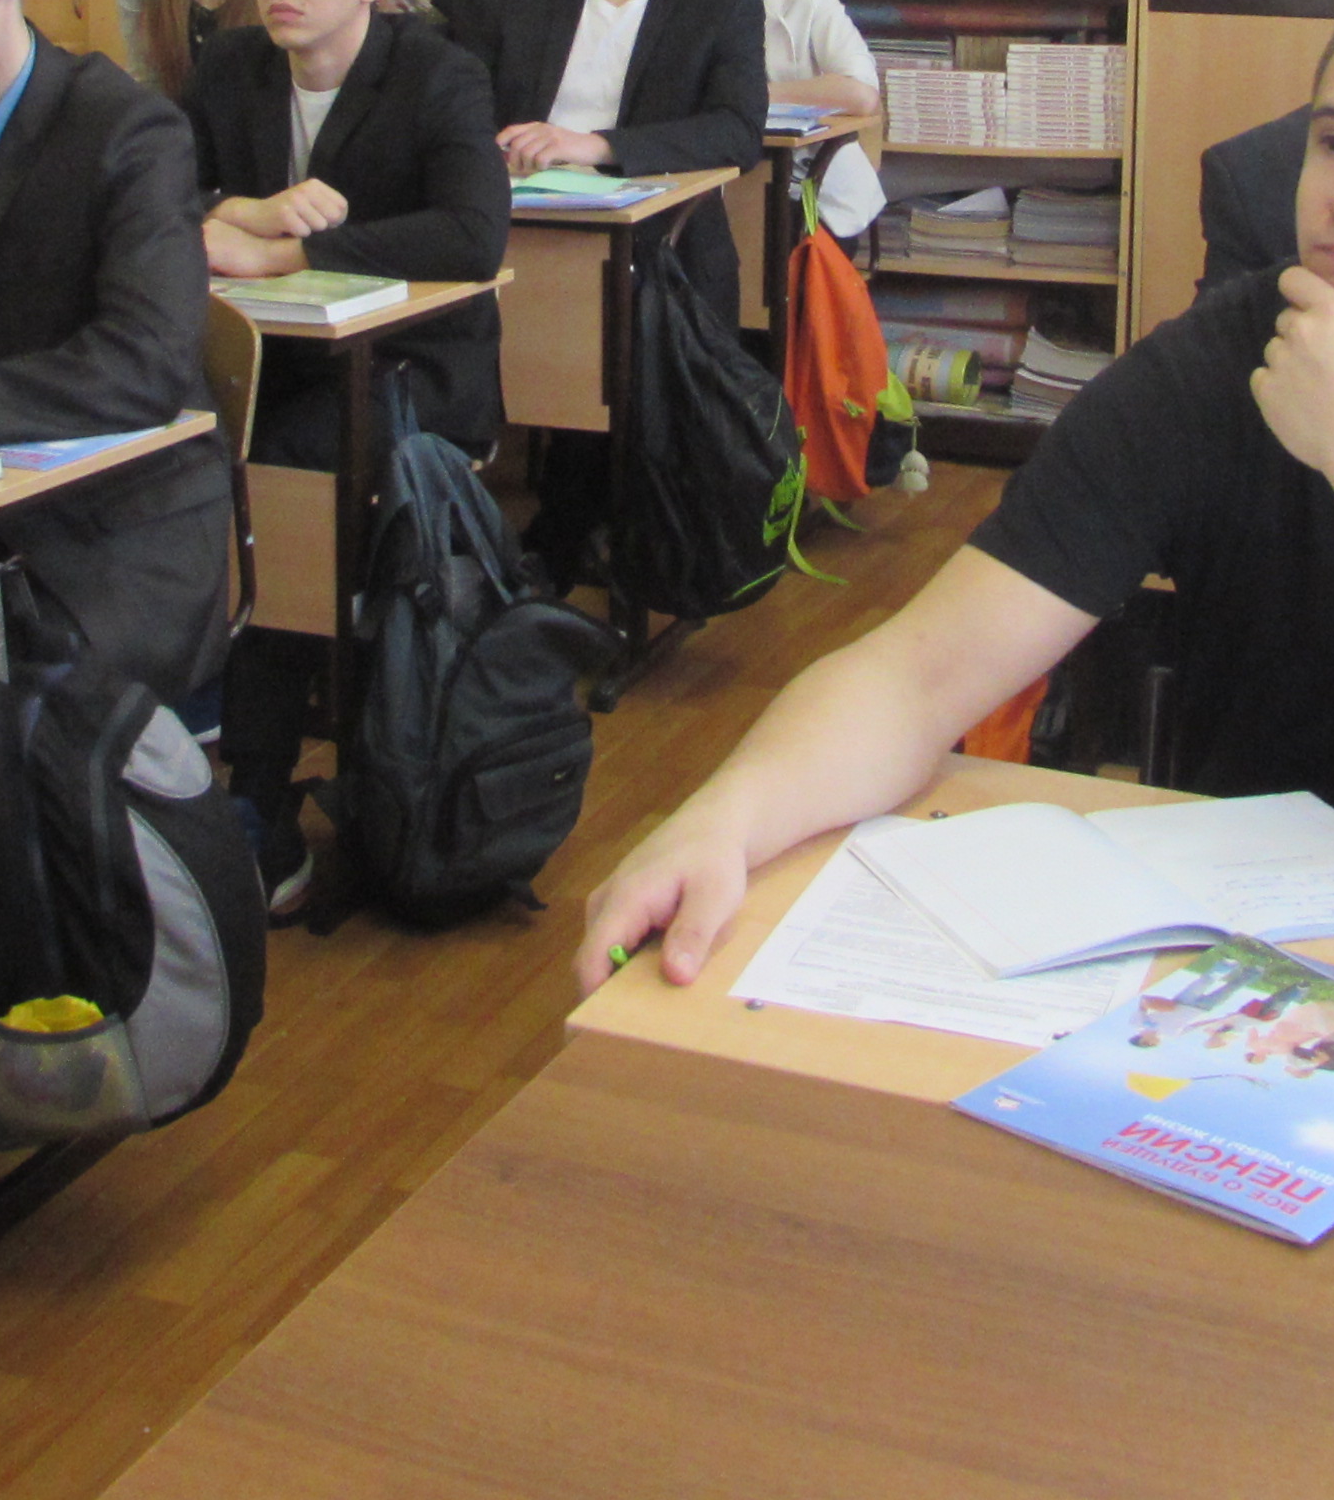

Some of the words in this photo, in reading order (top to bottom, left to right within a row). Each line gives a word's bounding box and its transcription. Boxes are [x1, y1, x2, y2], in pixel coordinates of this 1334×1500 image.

[1100, 1137, 1221, 1184] БУДУЩЕЙ
[1118, 1121, 1326, 1204] ПЕНСИИ
[1249, 1189, 1302, 1216] ВСЕ
